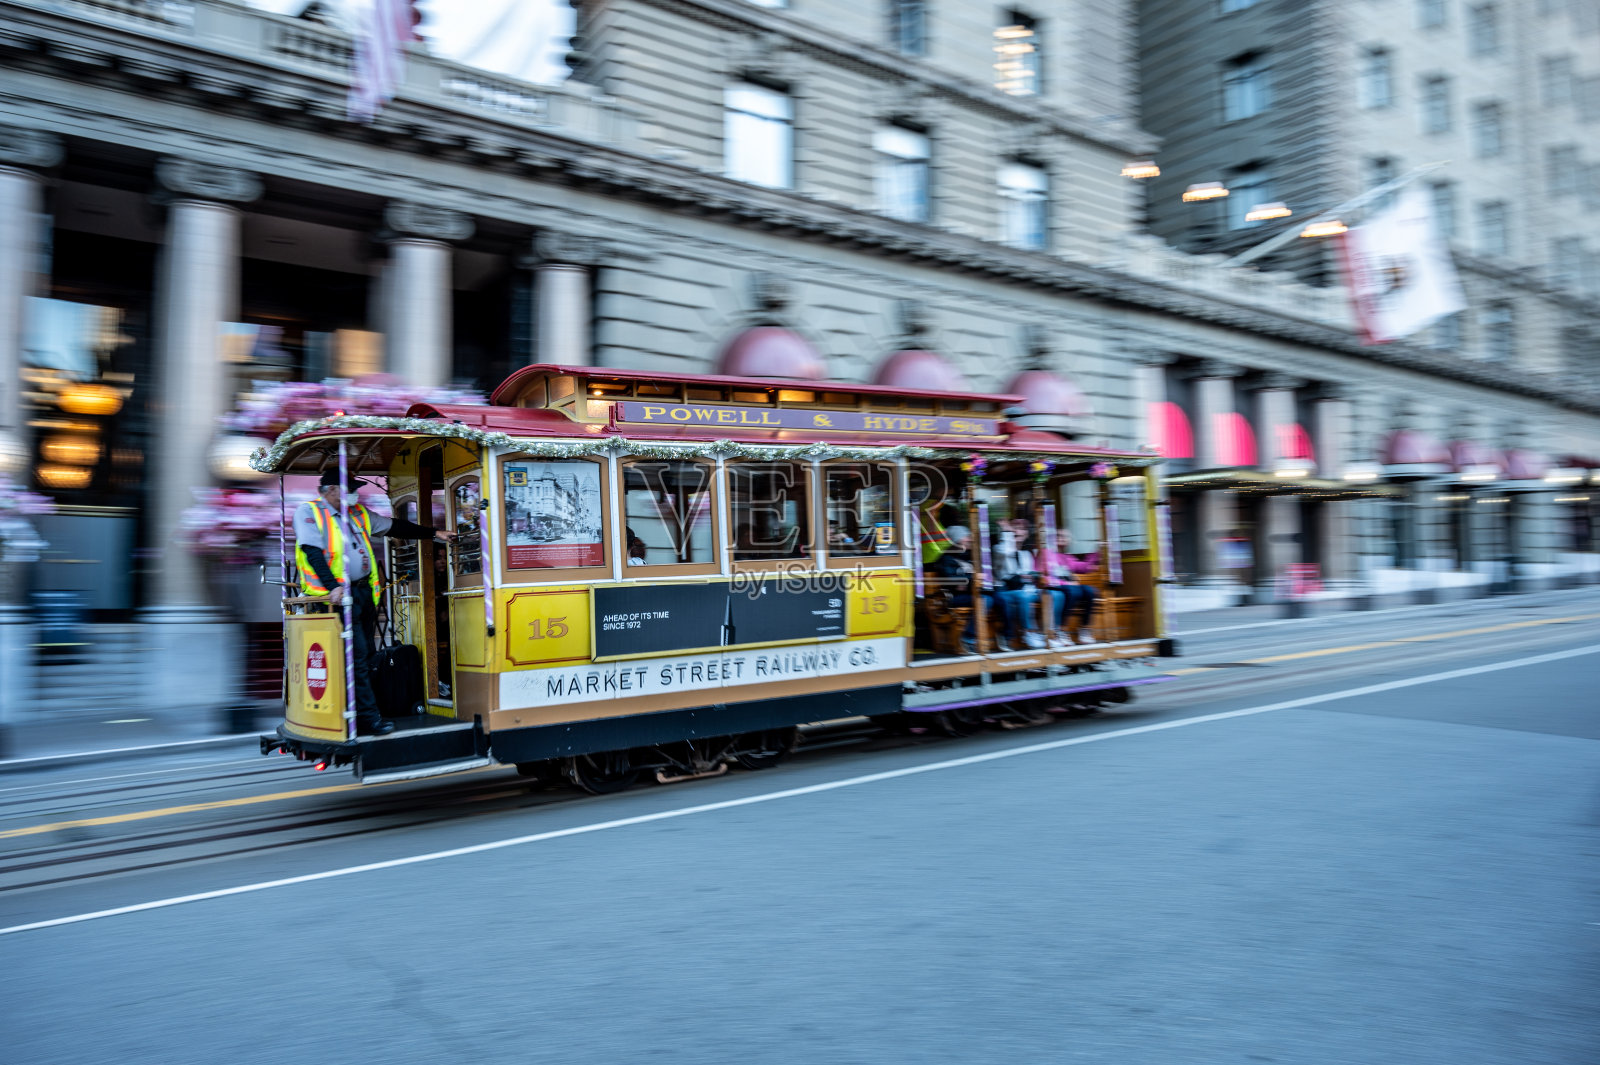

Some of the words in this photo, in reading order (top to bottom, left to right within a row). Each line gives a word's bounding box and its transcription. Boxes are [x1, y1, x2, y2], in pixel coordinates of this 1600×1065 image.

[642, 406, 782, 425] POWELL
[812, 413, 835, 427] &
[863, 416, 938, 431] HYDE
[859, 595, 889, 615] 15
[603, 614, 629, 623] AHEAD
[629, 613, 640, 621] OF
[640, 612, 652, 620] ITS
[652, 611, 670, 619] TIME
[603, 622, 625, 631] SINCE
[626, 620, 641, 629] 1972
[527, 616, 569, 641] 15
[547, 668, 648, 698] MARKET
[660, 658, 746, 686] STREET
[755, 649, 842, 677] RAILWAY
